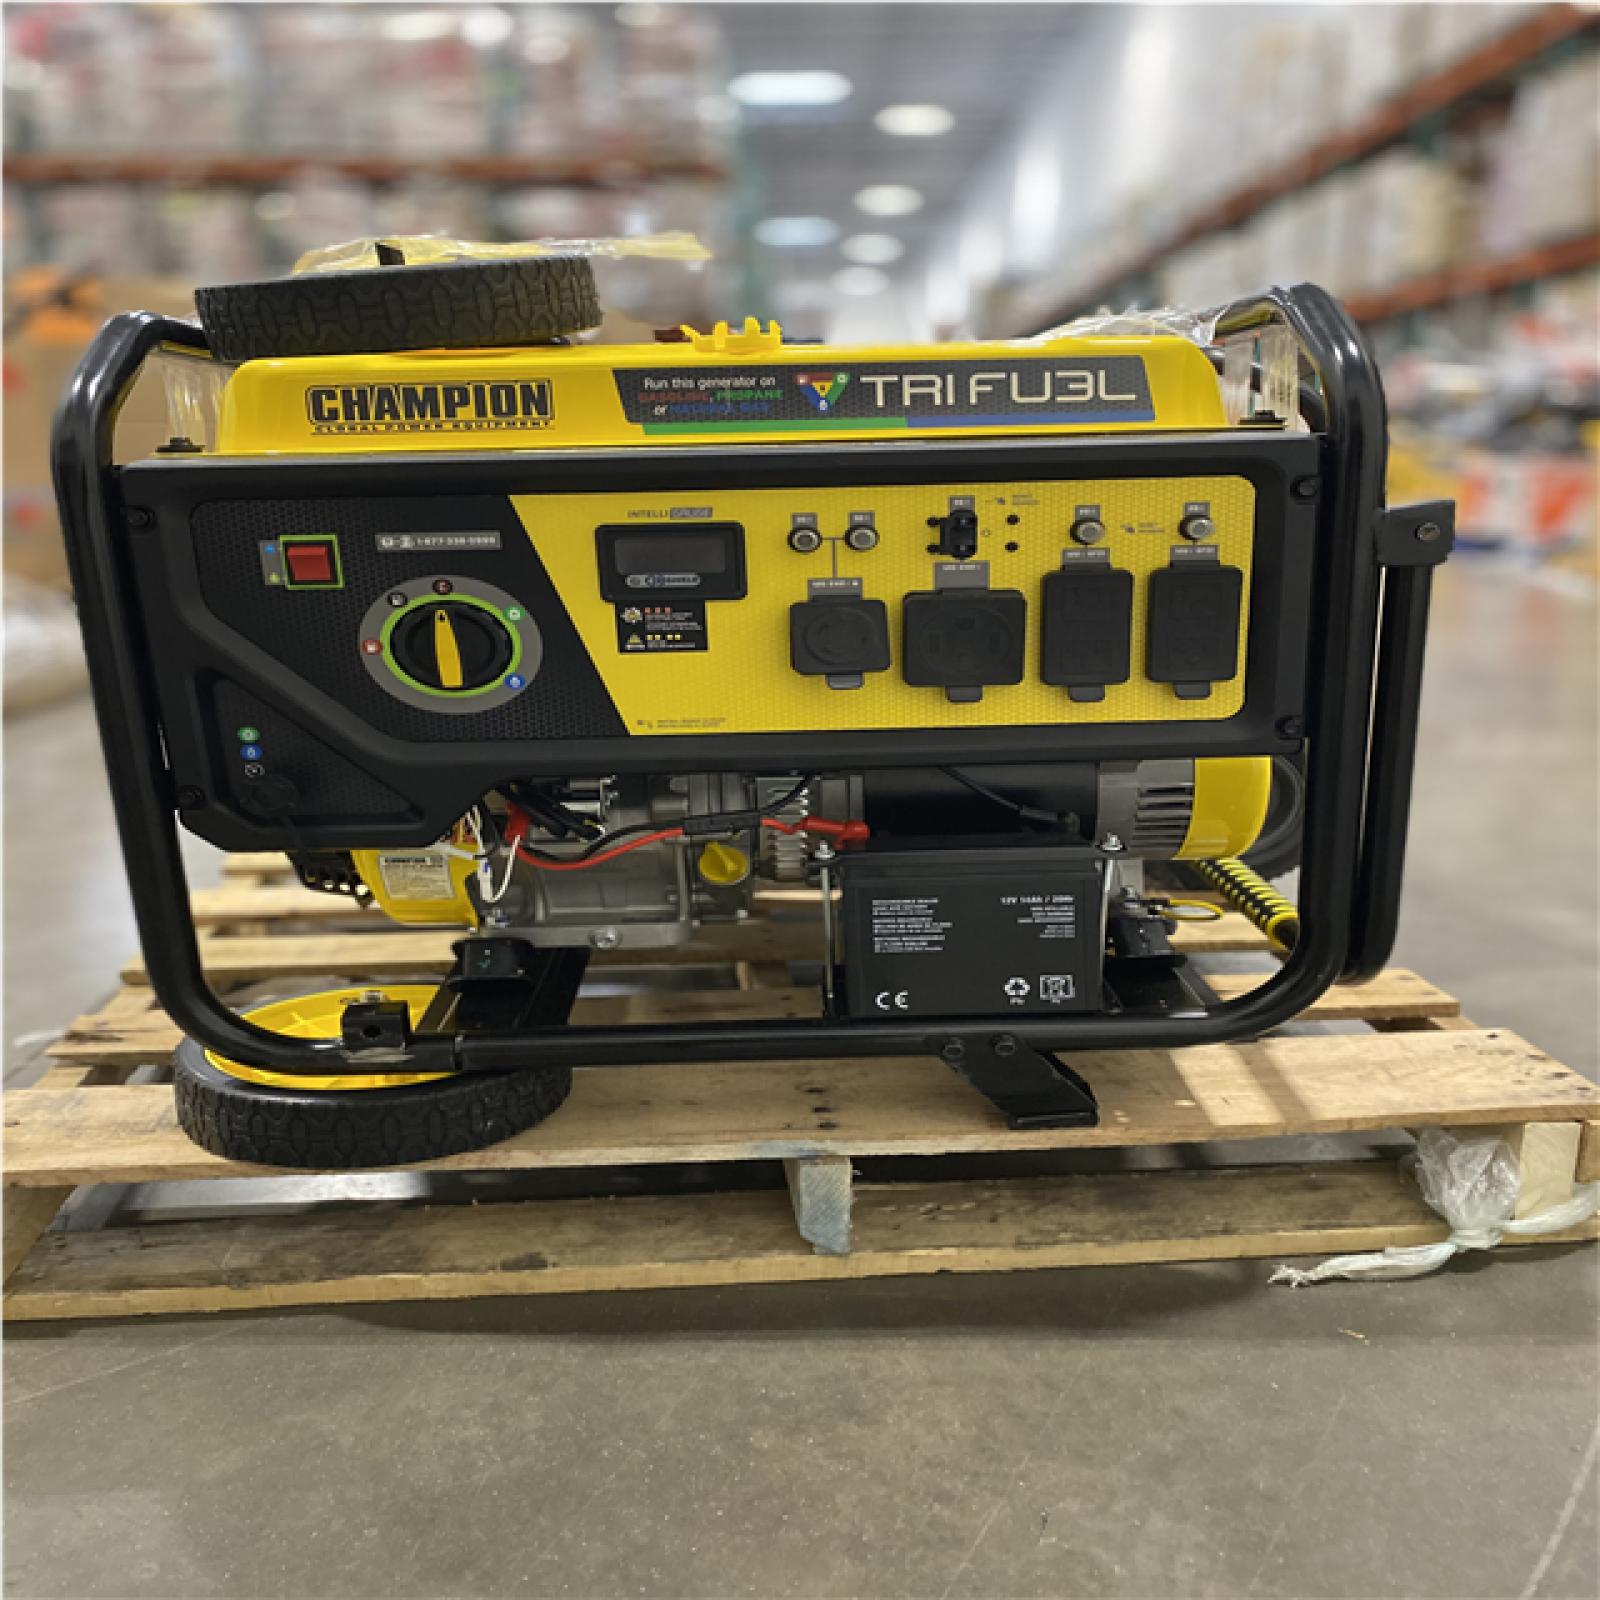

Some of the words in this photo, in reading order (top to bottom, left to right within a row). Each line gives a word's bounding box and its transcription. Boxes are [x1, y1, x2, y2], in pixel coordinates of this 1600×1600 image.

[643, 377, 669, 390] Run
[671, 376, 695, 389] this
[697, 376, 757, 391] generator
[759, 376, 776, 388] on
[859, 372, 955, 408] TRI
[715, 388, 785, 400] PROPANE
[311, 382, 548, 422] CHAMPION
[653, 403, 667, 416] or
[451, 418, 551, 432] EQUIPMENT
